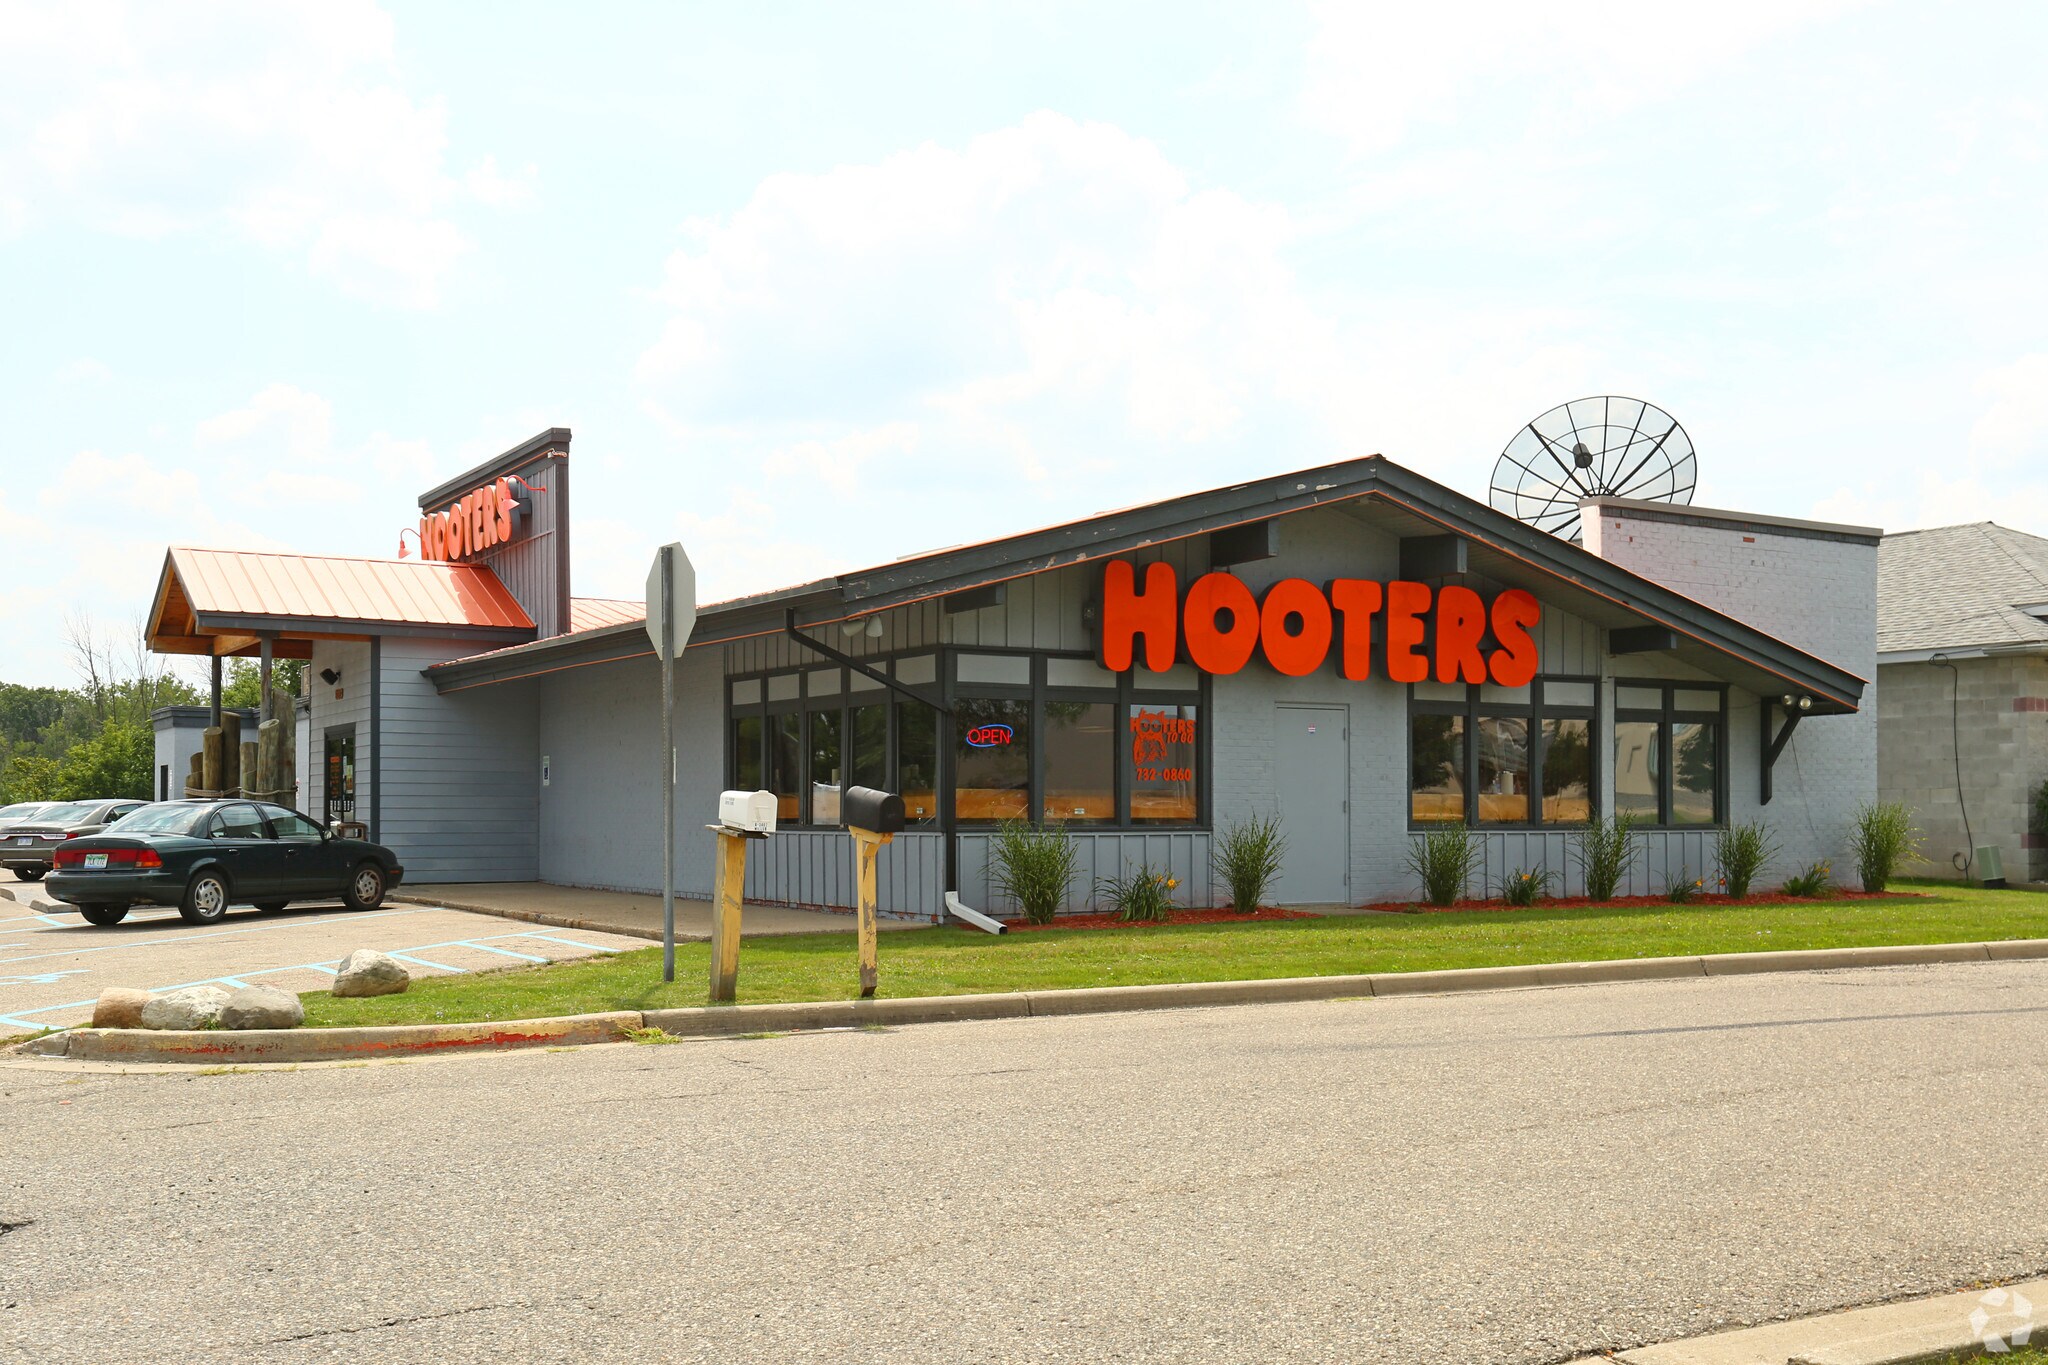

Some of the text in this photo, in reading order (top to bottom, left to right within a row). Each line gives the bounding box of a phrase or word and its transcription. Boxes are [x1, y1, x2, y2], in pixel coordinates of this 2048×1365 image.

[1101, 559, 1541, 688] HOOTERS
[967, 726, 1011, 745] OPEN
[1167, 731, 1194, 743] TO GO
[1136, 767, 1192, 782] 732-0860
